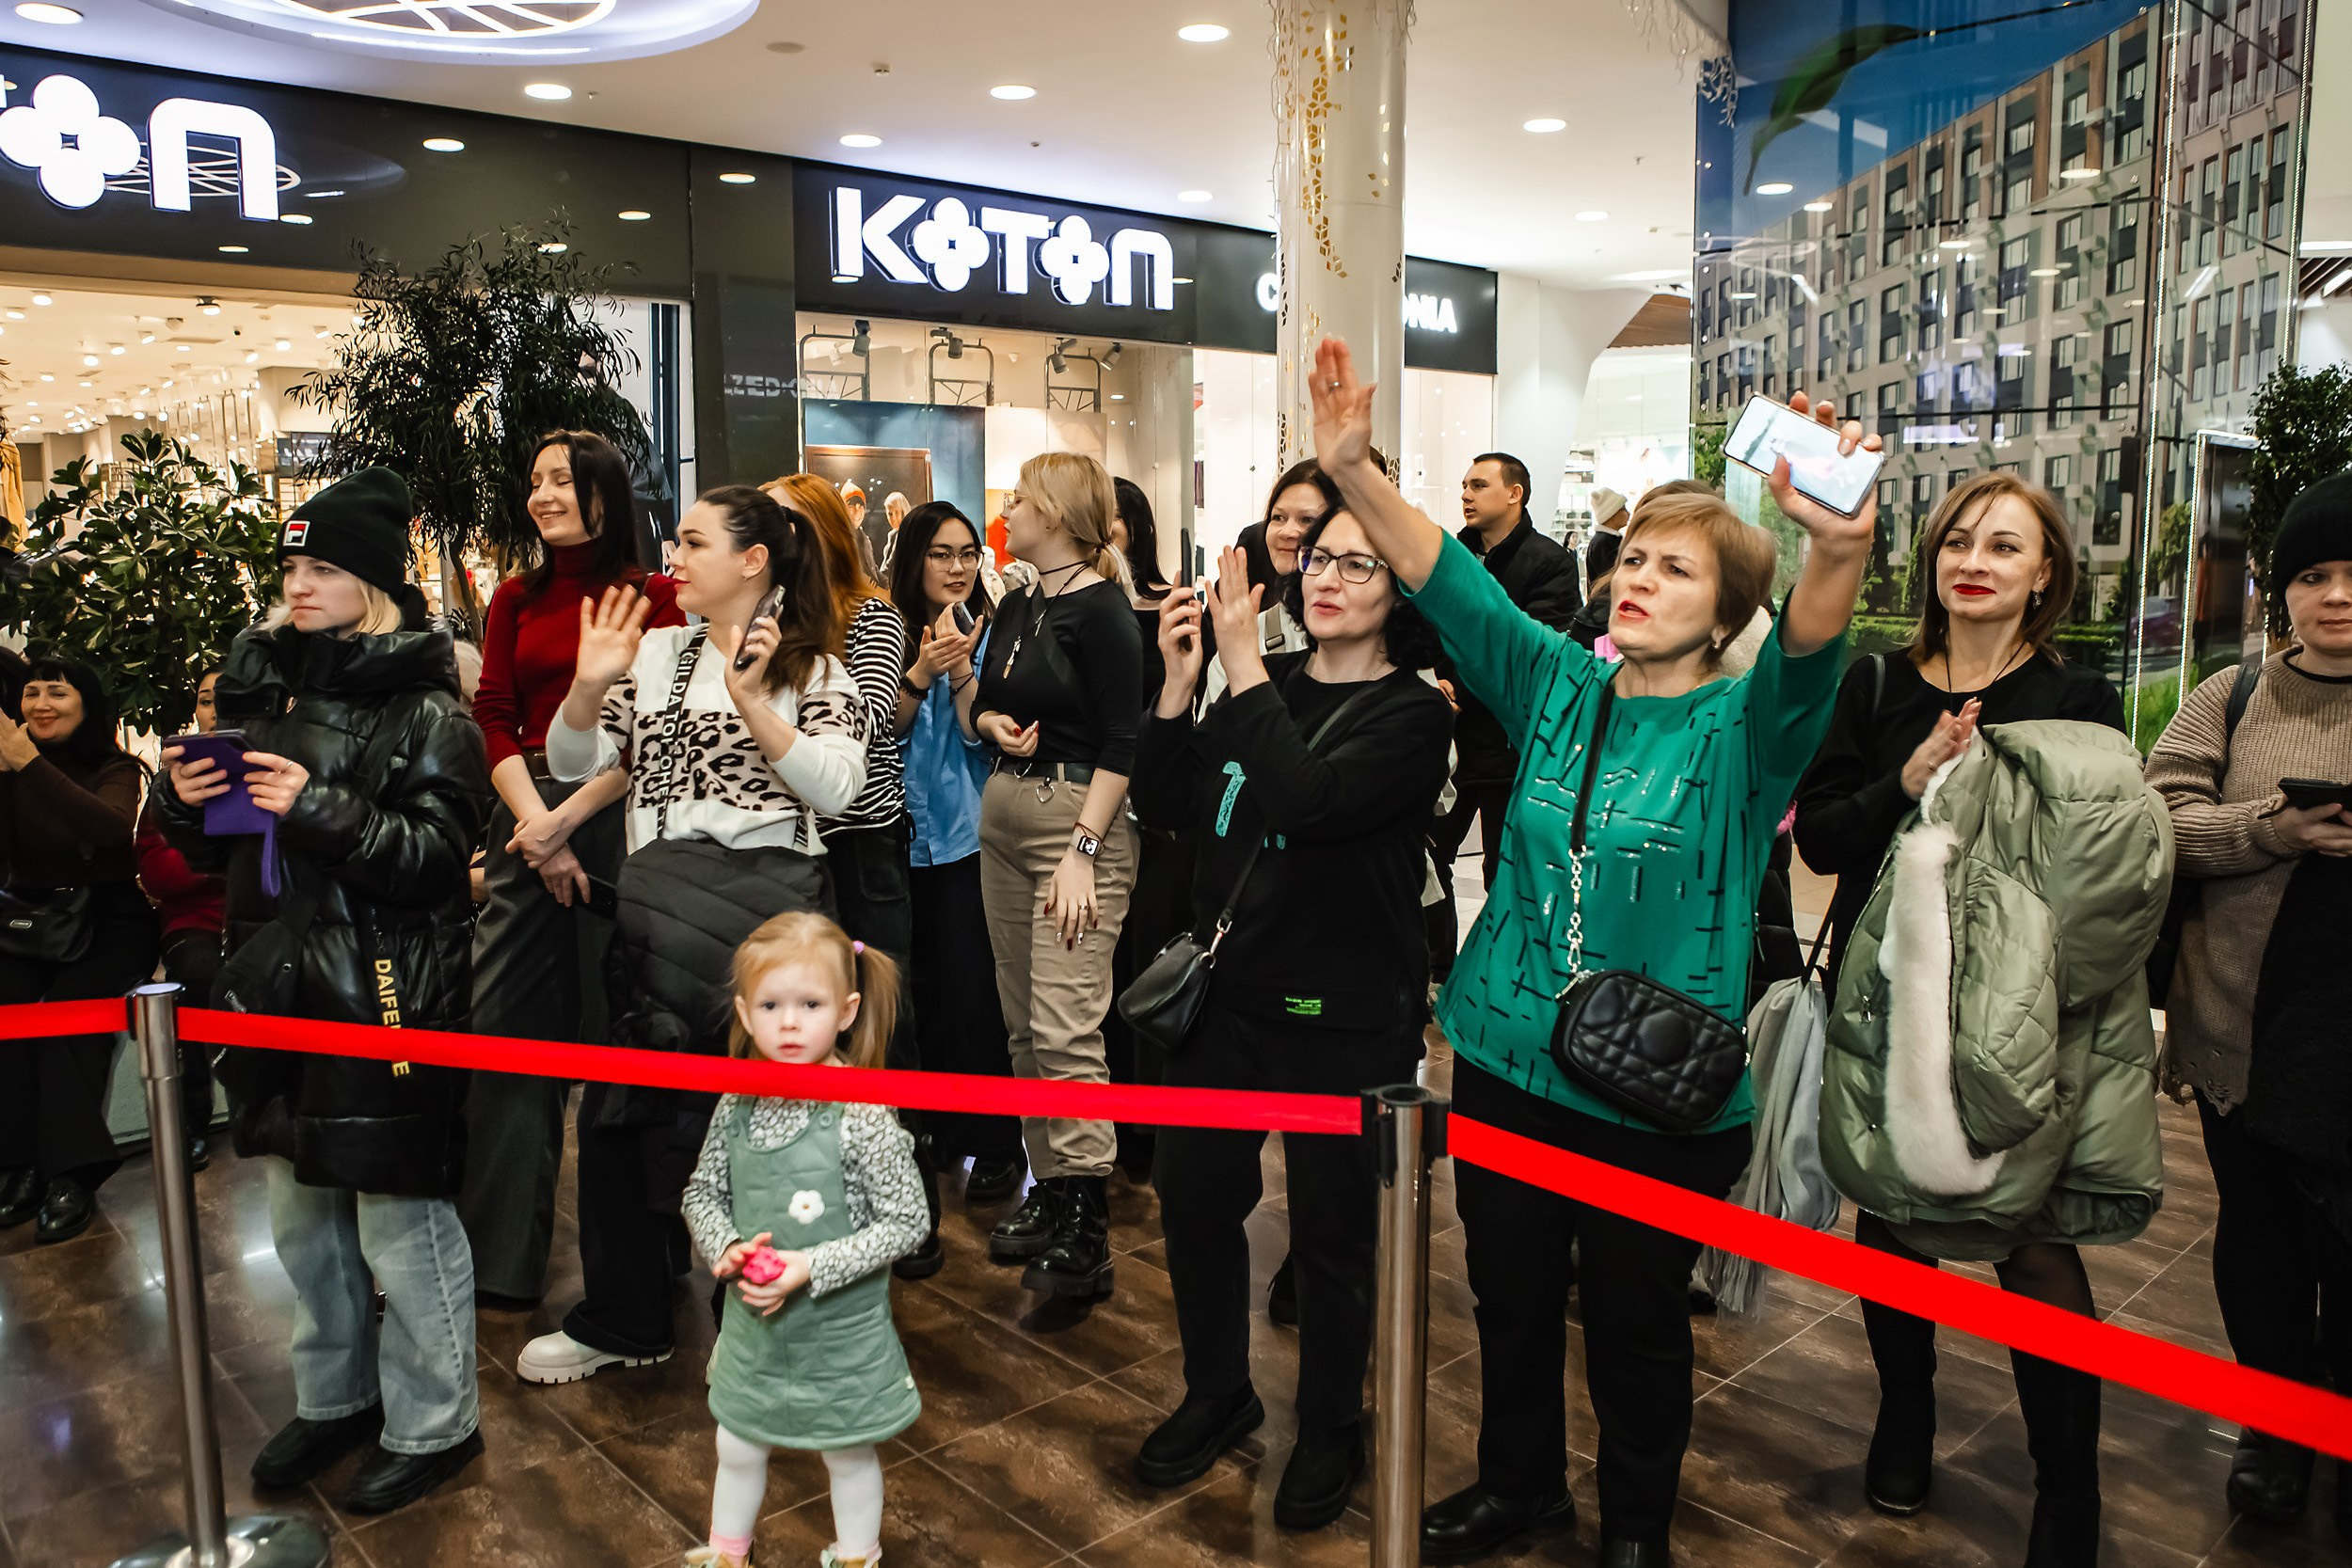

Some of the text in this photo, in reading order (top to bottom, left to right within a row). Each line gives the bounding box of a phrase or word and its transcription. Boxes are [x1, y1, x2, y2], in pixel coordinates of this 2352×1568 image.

[0, 73, 278, 221] ON
[828, 186, 1174, 311] KOTON
[668, 648, 695, 706] GILDA
[374, 958, 410, 1078] DAIFEE
